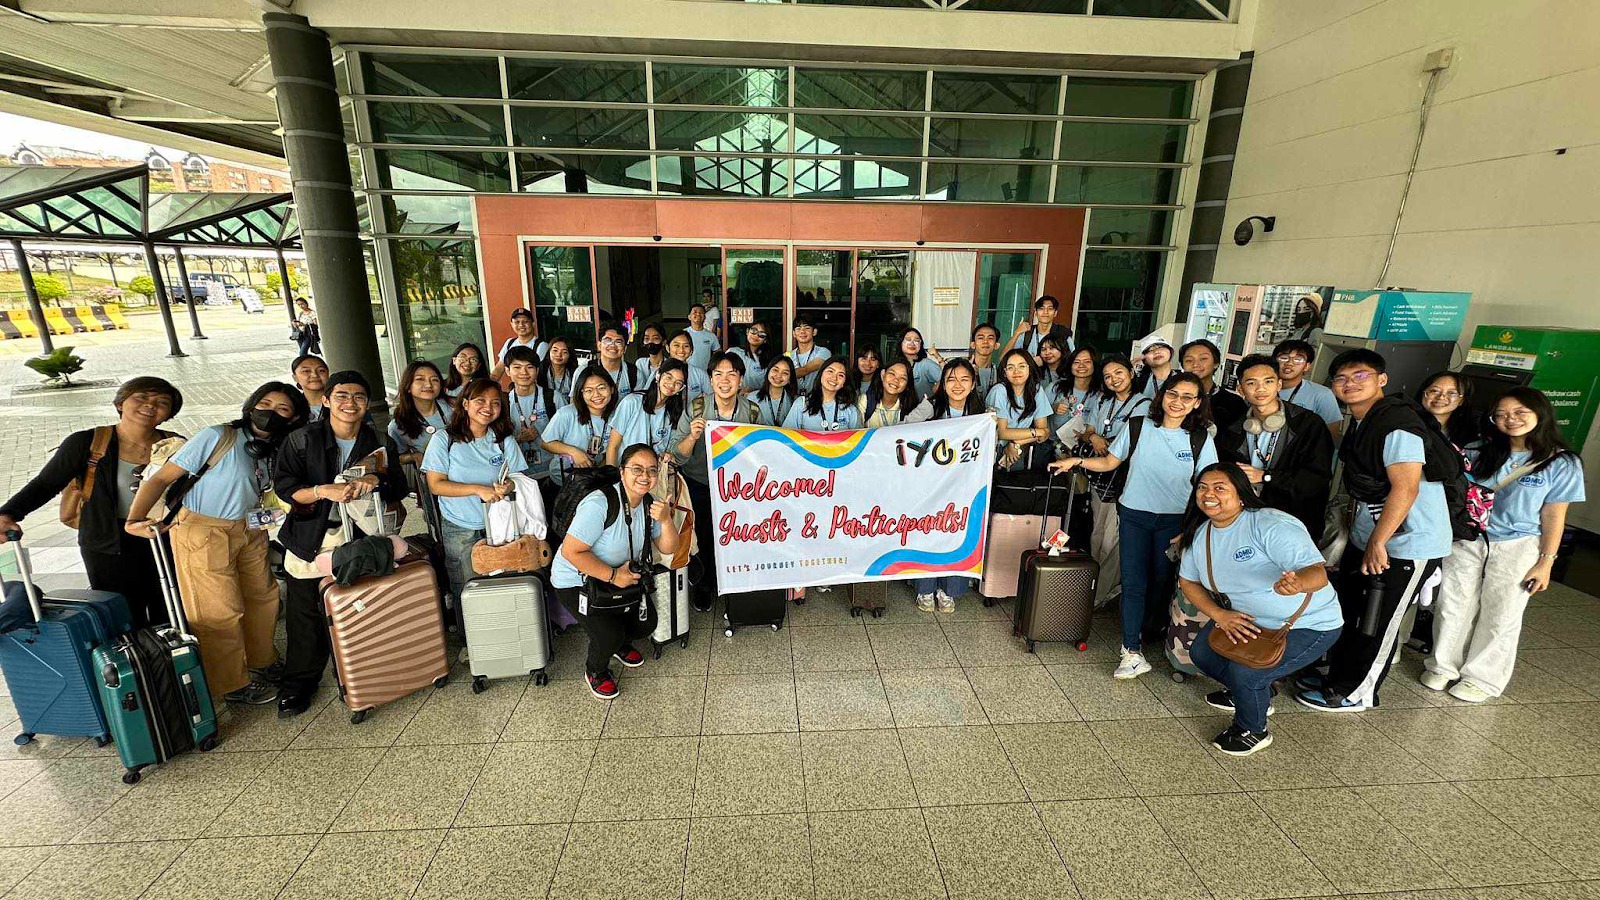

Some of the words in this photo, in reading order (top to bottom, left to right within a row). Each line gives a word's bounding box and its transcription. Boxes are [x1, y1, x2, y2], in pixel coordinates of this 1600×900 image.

[1483, 343, 1523, 353] LANDBANK
[961, 437, 980, 451] 20
[960, 450, 979, 463] 24
[717, 465, 835, 502] Welcome!
[1520, 476, 1544, 485] ADMU
[801, 511, 819, 539] &
[828, 502, 969, 546] Participants!
[1235, 548, 1253, 559] ADMU
[726, 564, 751, 573] LET'S
[755, 560, 796, 571] JOURNEY
[799, 556, 848, 568] TOGETHER!
